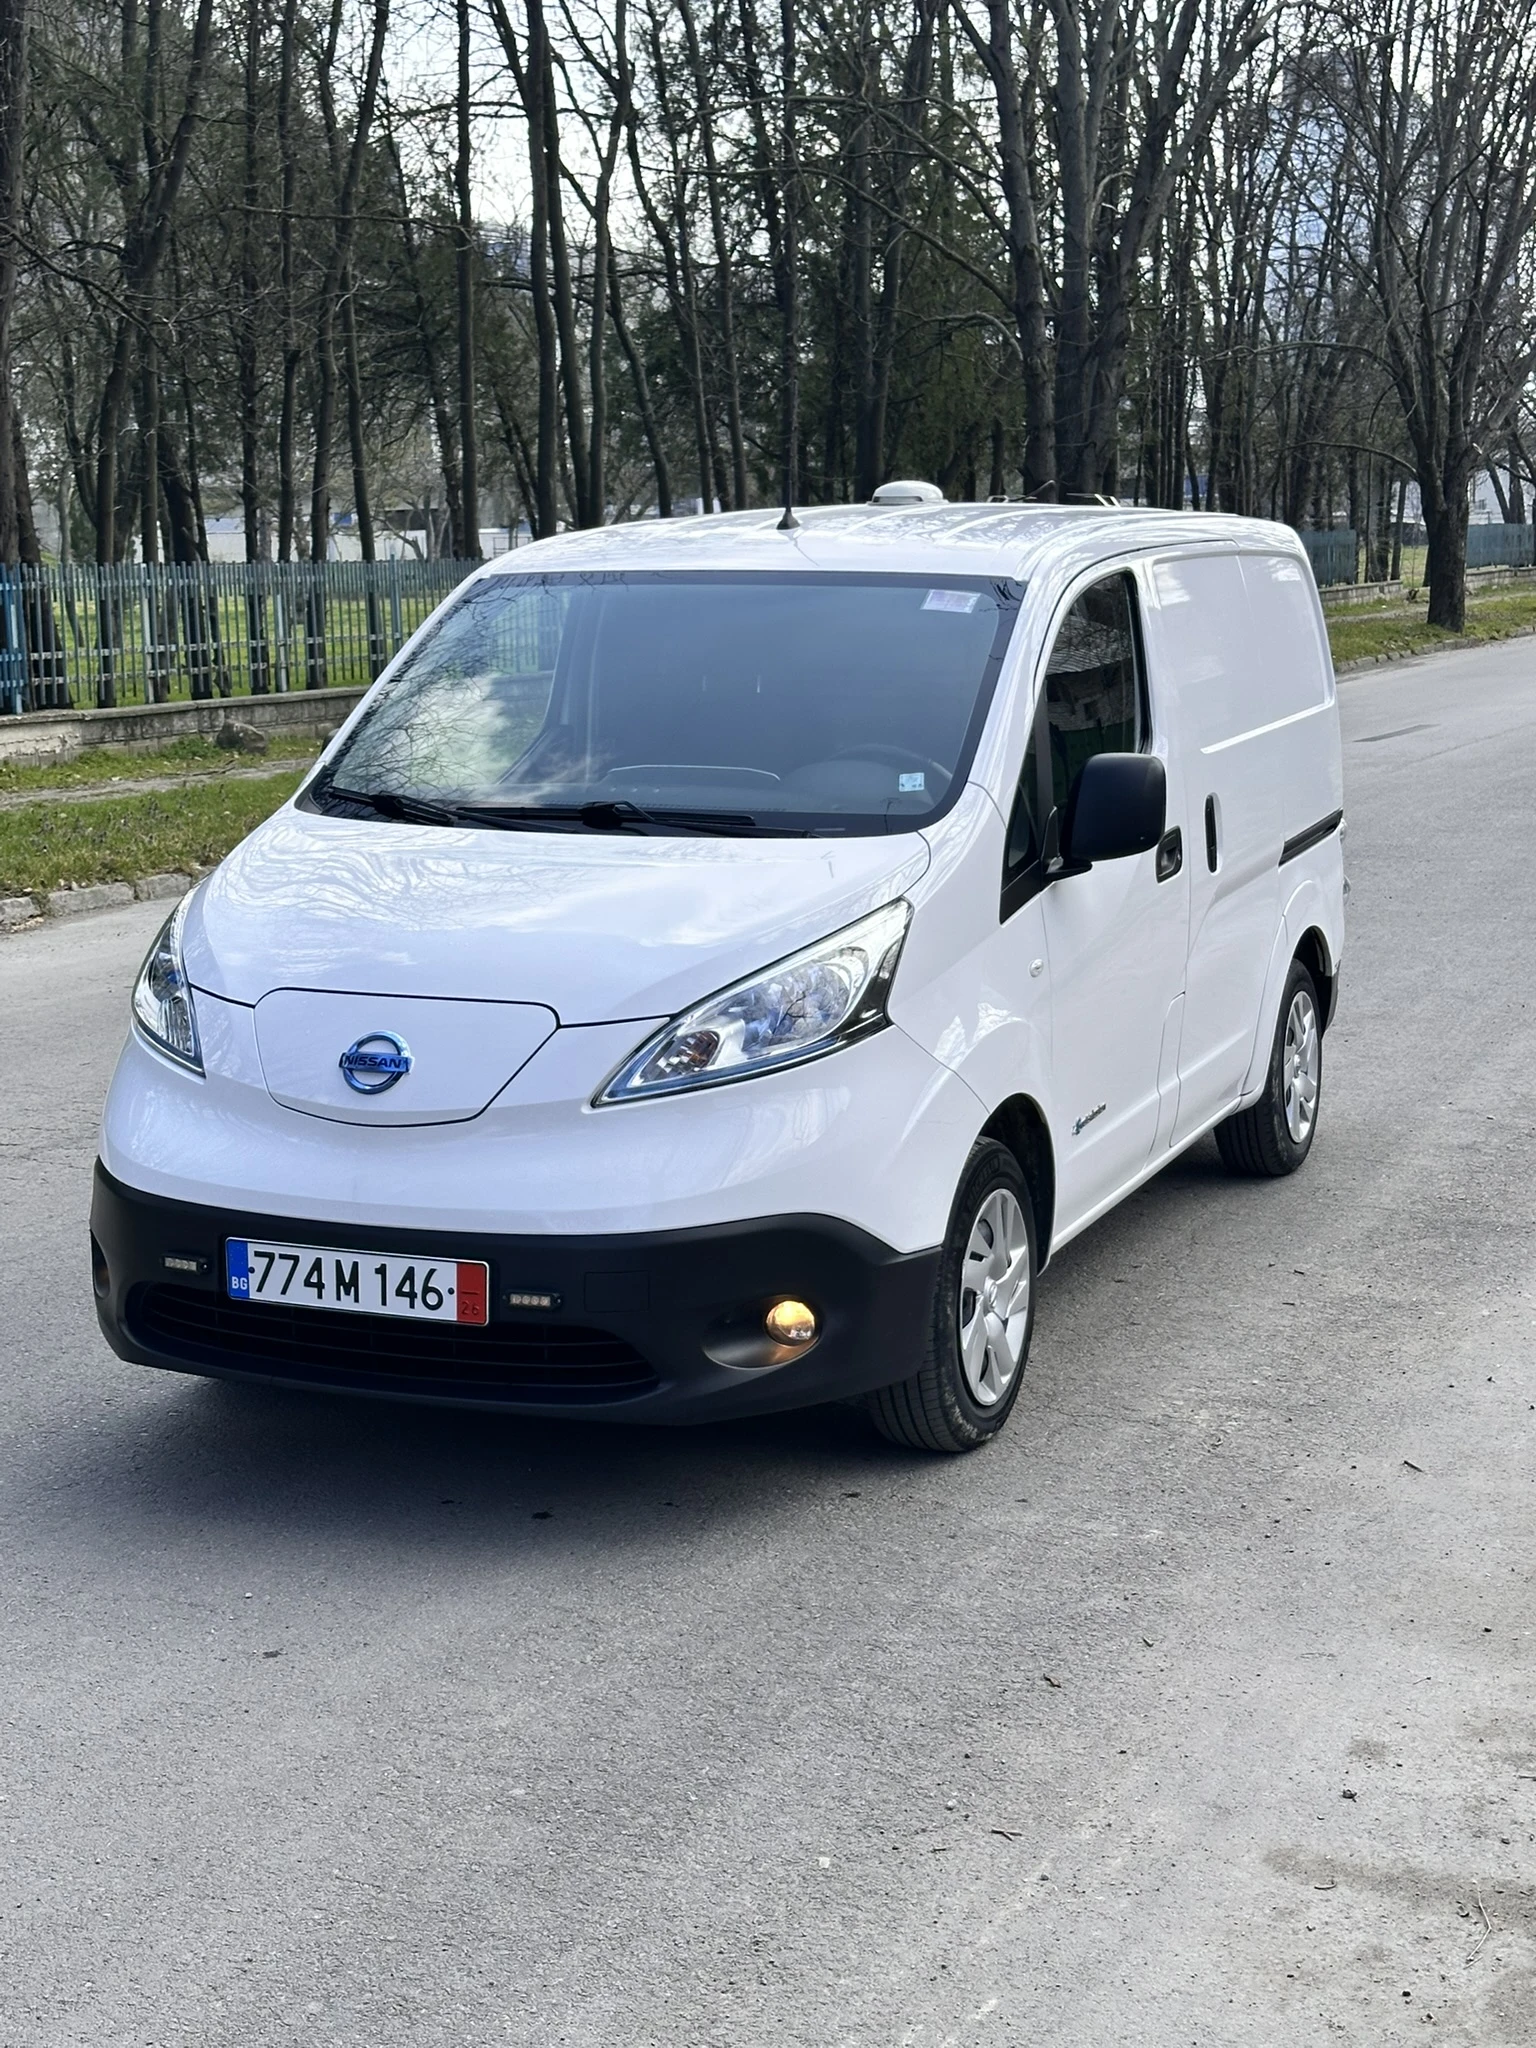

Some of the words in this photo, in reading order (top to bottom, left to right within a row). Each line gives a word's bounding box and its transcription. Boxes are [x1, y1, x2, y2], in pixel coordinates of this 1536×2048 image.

[343, 1055, 401, 1069] NISSAN
[231, 1276, 248, 1290] BG
[253, 1250, 325, 1300] 774
[335, 1258, 360, 1303] M
[374, 1263, 444, 1311] 146
[461, 1300, 480, 1317] 26
